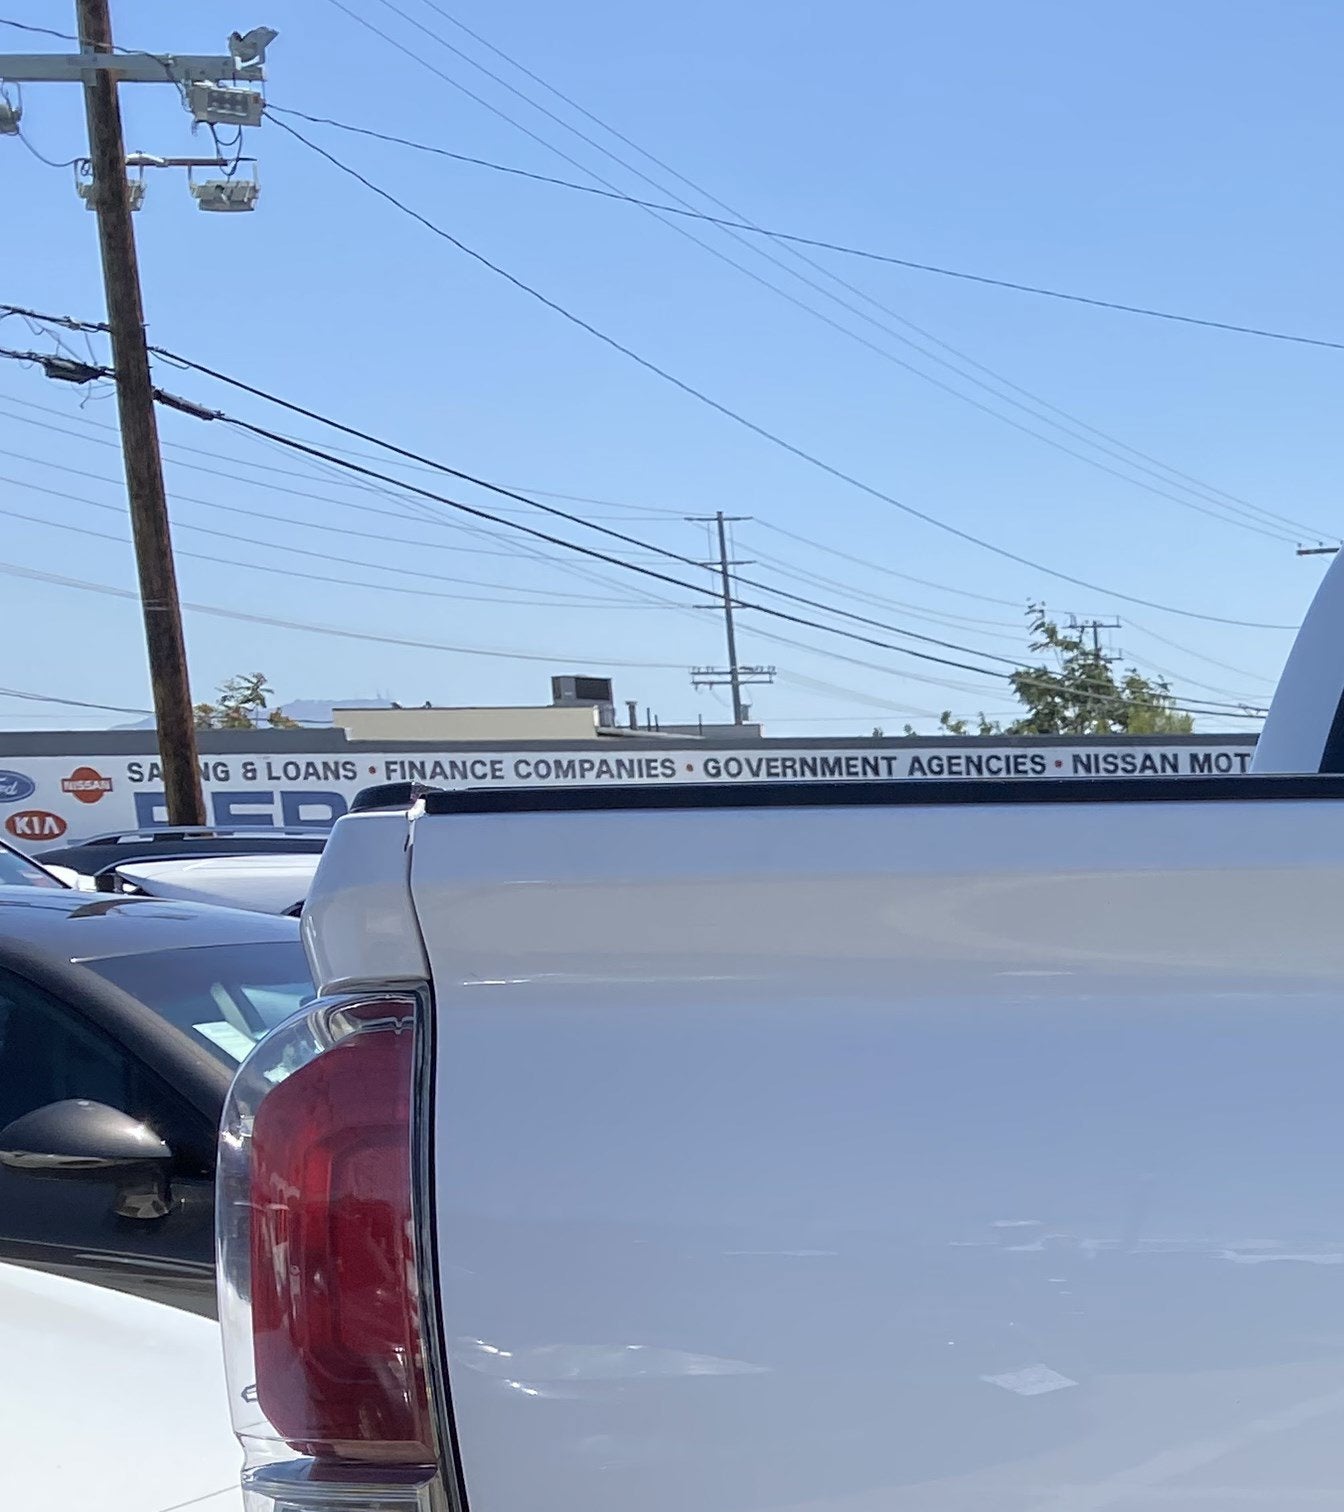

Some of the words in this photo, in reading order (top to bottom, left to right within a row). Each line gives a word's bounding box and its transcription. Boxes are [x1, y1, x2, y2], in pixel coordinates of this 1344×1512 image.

[127, 761, 230, 783] SANG
[241, 761, 258, 782] &
[266, 760, 358, 782] LOANS
[384, 759, 504, 782] FINANCE
[513, 757, 677, 780] COMPANIES
[702, 756, 898, 779] GOVERNMENT
[907, 754, 1047, 777] AGENCIES
[1072, 752, 1180, 775] NISSAN
[63, 779, 111, 791] NISSAN
[13, 816, 60, 835] KIA
